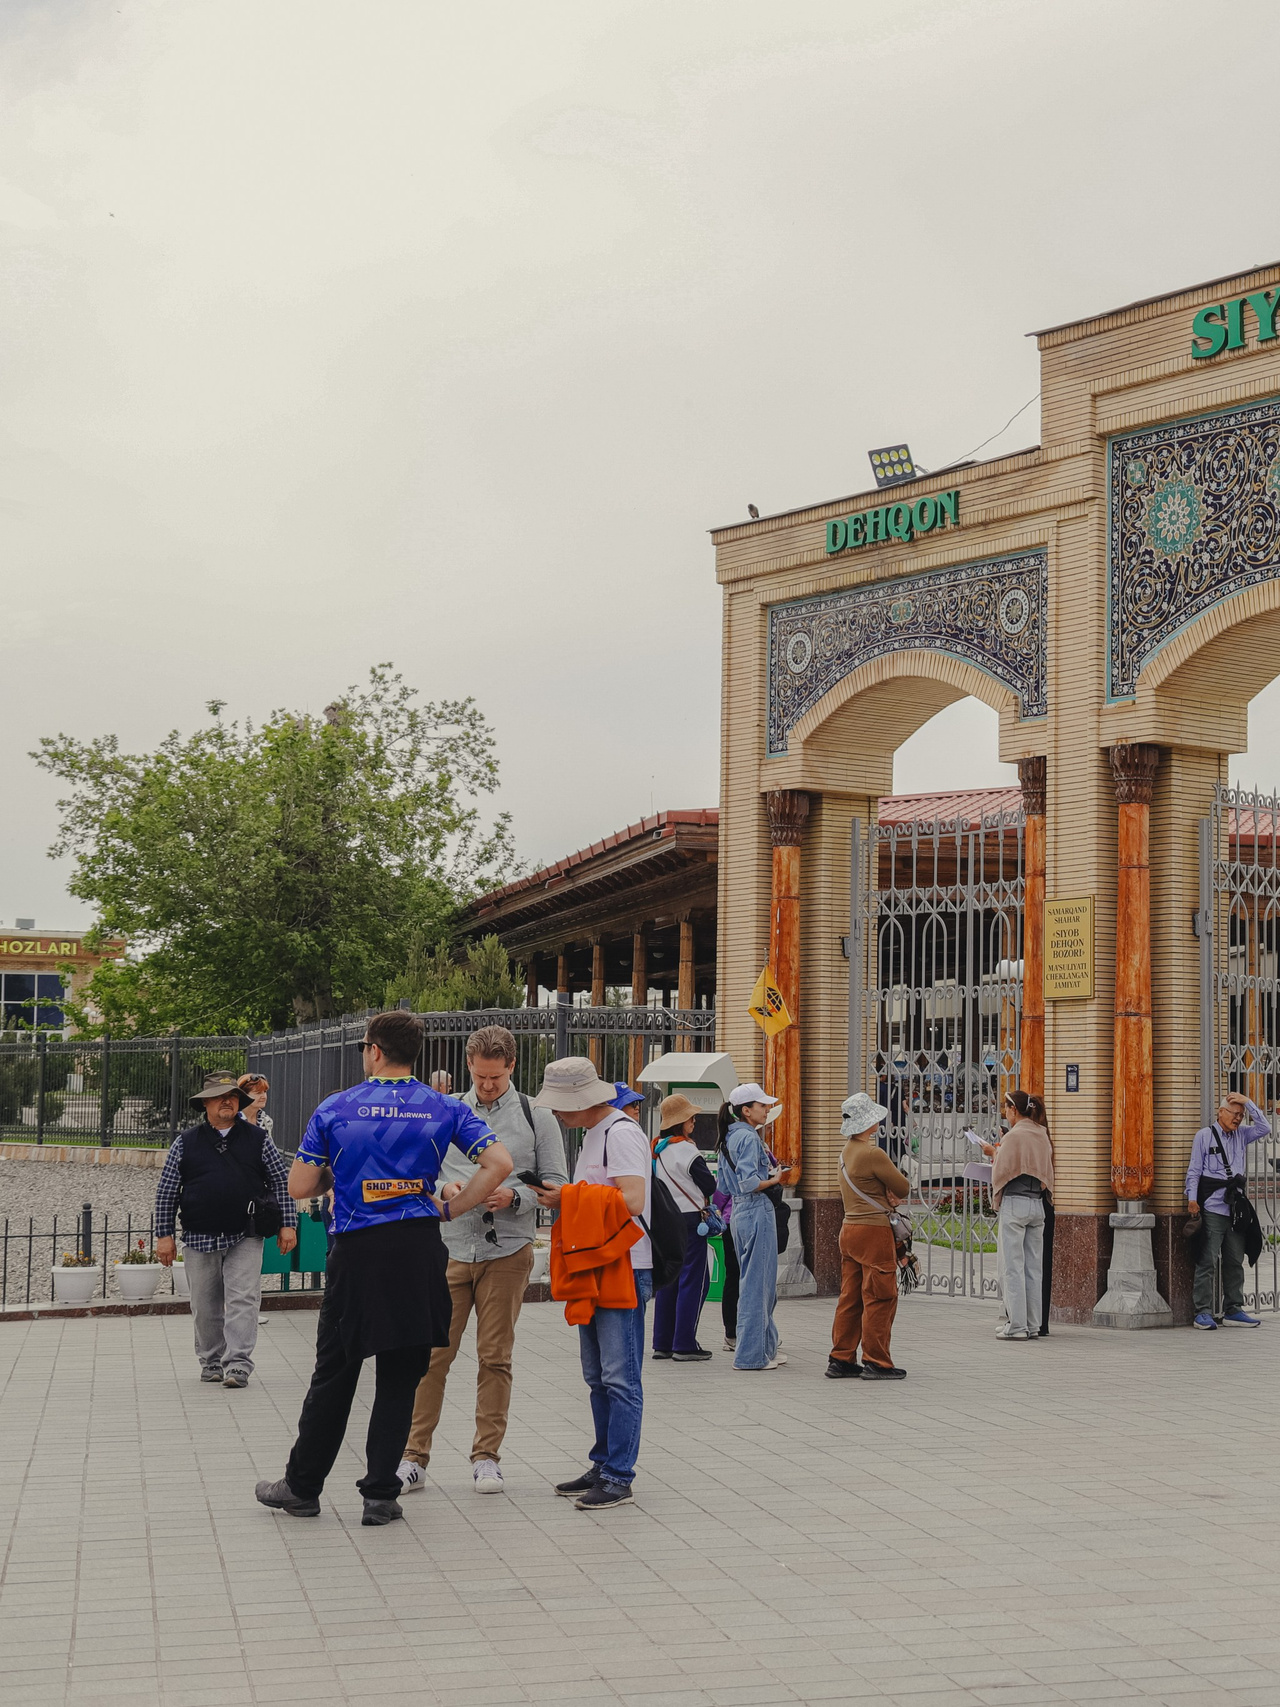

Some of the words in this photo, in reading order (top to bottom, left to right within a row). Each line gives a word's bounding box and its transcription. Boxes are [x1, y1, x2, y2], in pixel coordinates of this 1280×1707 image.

[826, 490, 960, 554] DEHQON
[1048, 906, 1087, 916] SAMARQAND
[1054, 916, 1080, 924] SHAHAR
[1050, 938, 1084, 949] DEHQON
[1046, 971, 1089, 981] CHEKLANGAN
[1054, 980, 1081, 989] JAMIYAT
[371, 1107, 398, 1118] FIJI
[366, 1182, 392, 1191] SHOP
